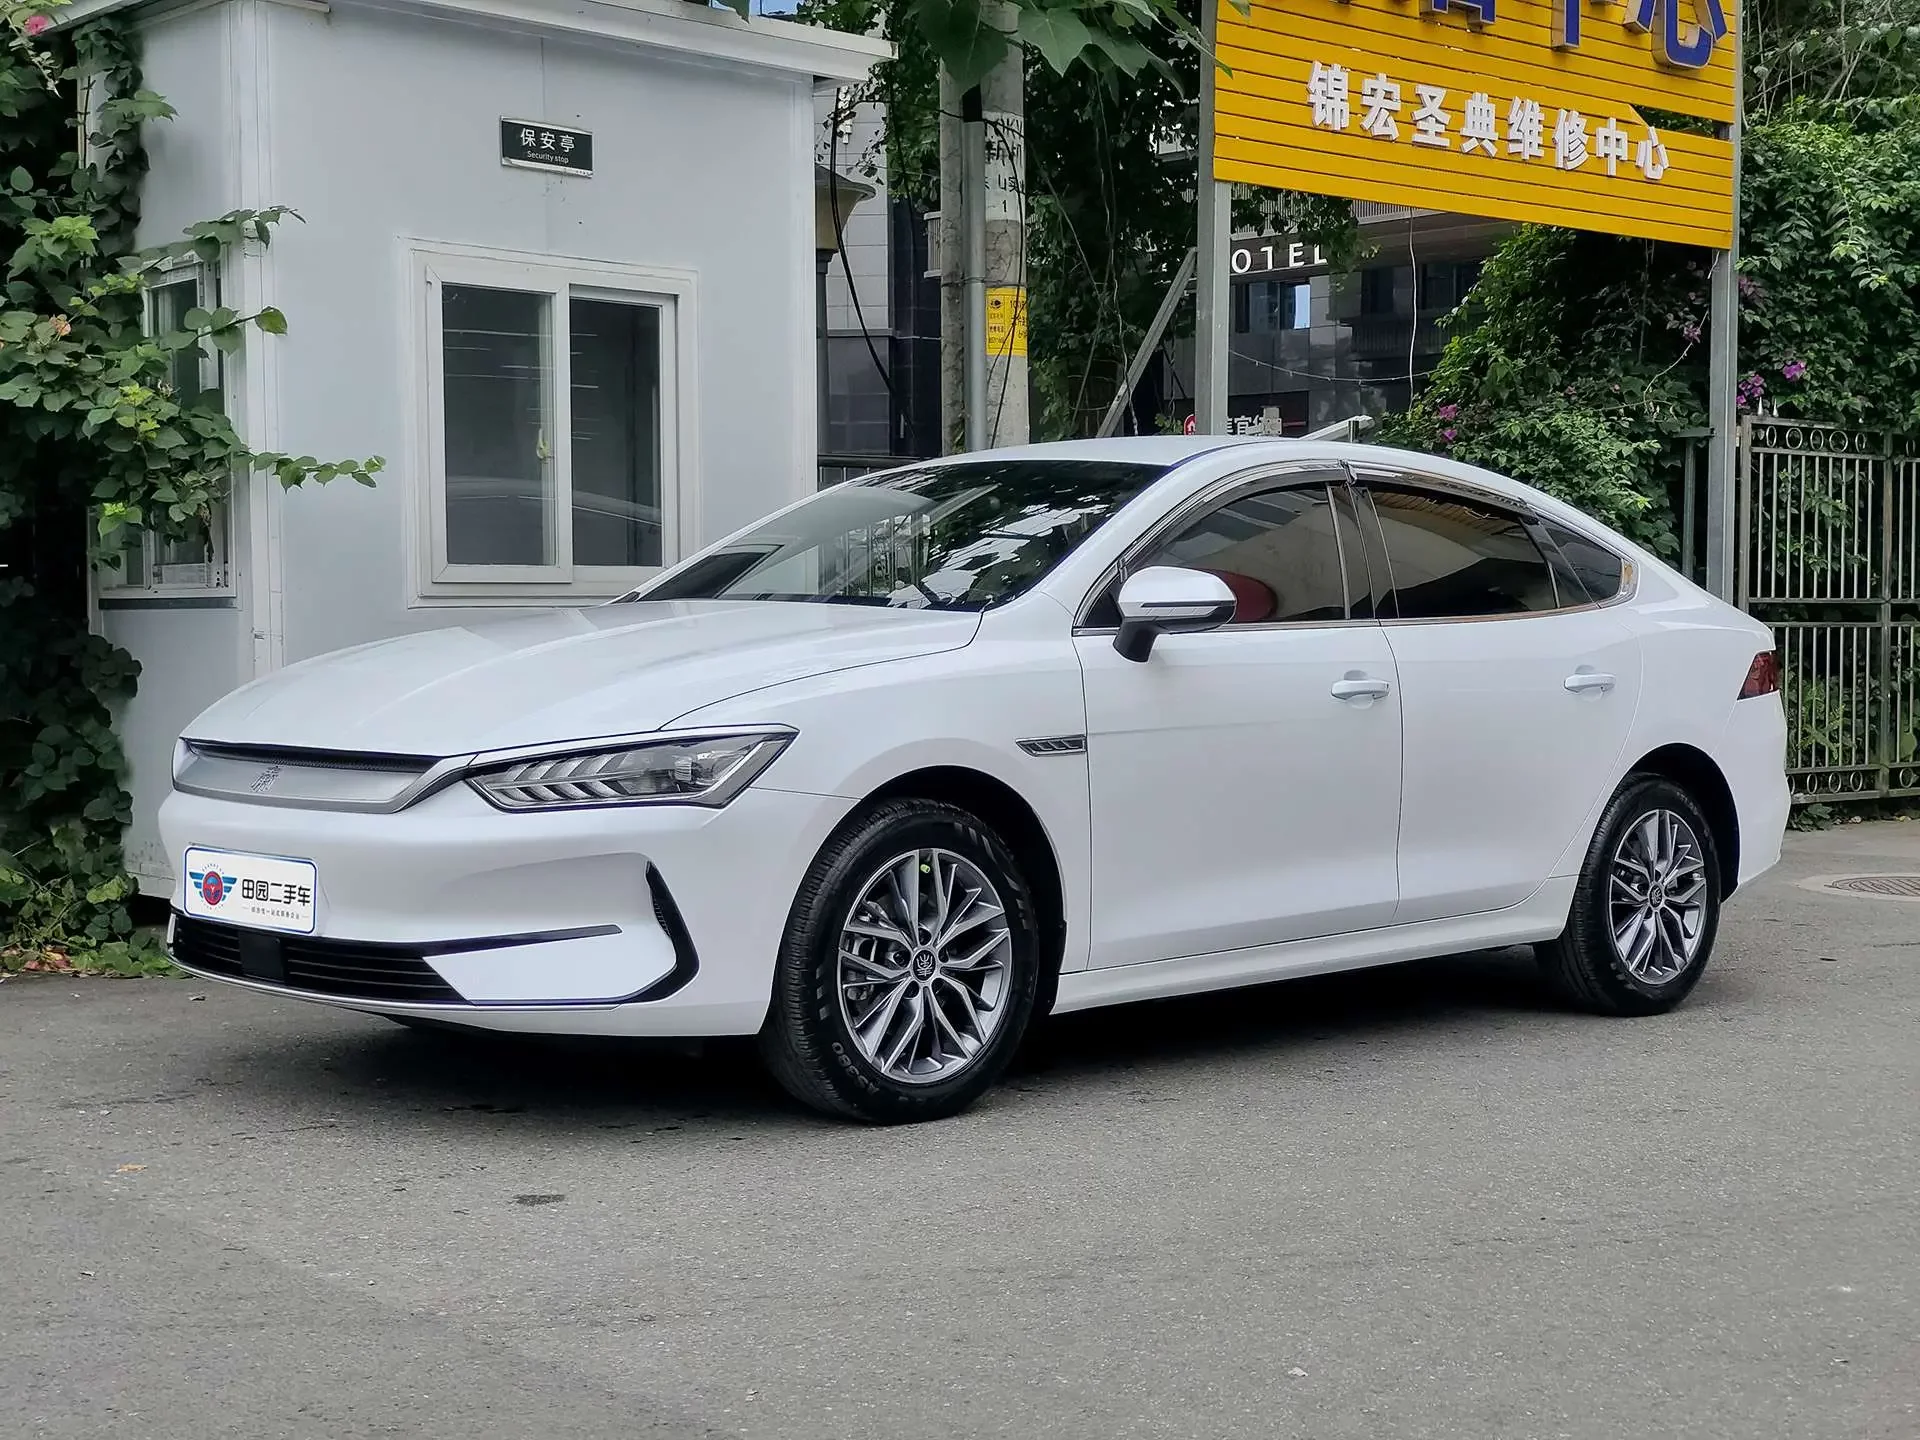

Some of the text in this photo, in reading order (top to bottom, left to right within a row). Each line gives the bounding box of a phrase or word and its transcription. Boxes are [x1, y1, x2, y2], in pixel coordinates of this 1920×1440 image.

[1306, 60, 1670, 181] 锦宏圣典维修中心
[520, 127, 575, 153] 保安亭
[527, 150, 569, 164] Security stop
[1231, 242, 1328, 274] OTEL
[241, 878, 312, 907] 田园二手车
